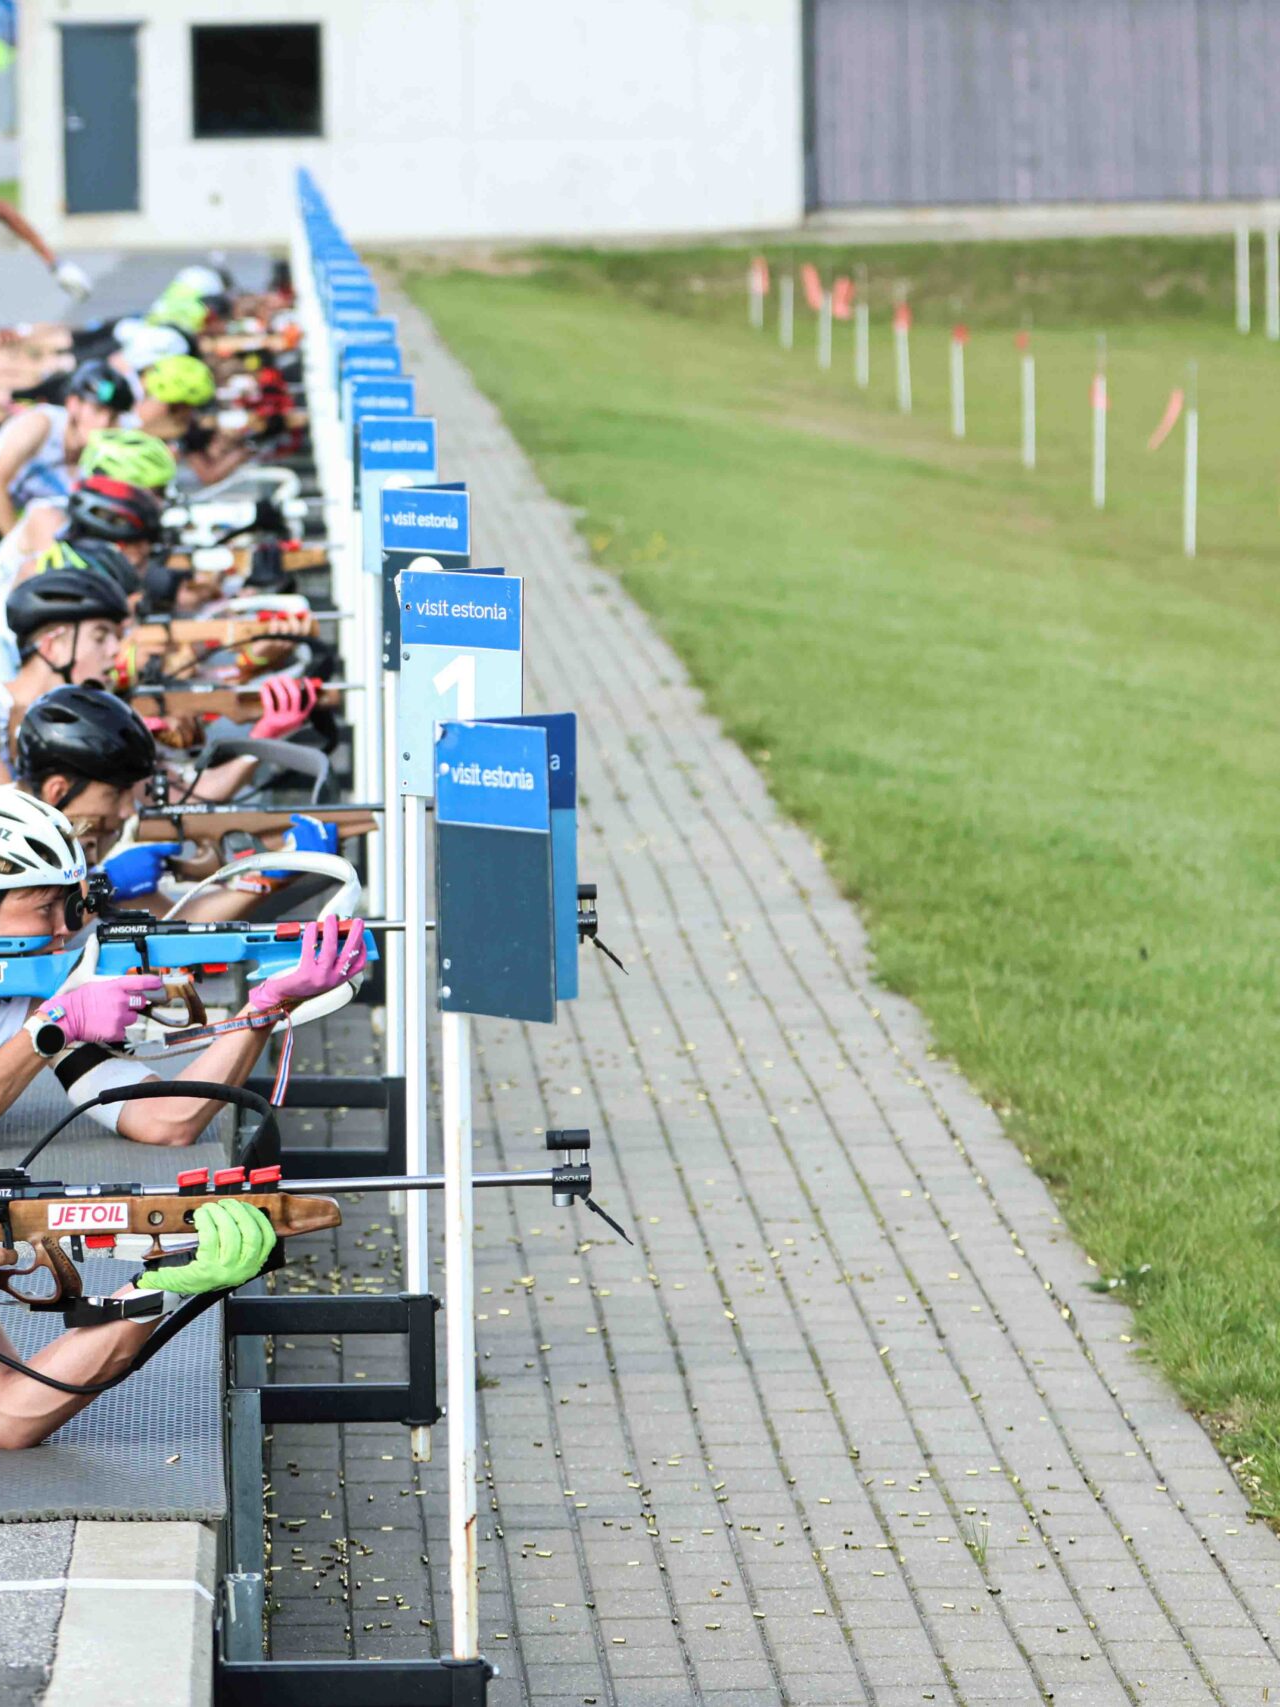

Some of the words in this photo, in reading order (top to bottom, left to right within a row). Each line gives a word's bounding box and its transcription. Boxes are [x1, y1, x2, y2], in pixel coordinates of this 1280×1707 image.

[392, 511, 416, 526] visit
[417, 513, 458, 530] estonia
[416, 599, 449, 617] visit
[451, 602, 507, 620] estonia
[432, 654, 476, 721] 1
[451, 762, 481, 785] visit
[482, 766, 534, 790] estonia
[52, 1205, 125, 1227] JETOIL
